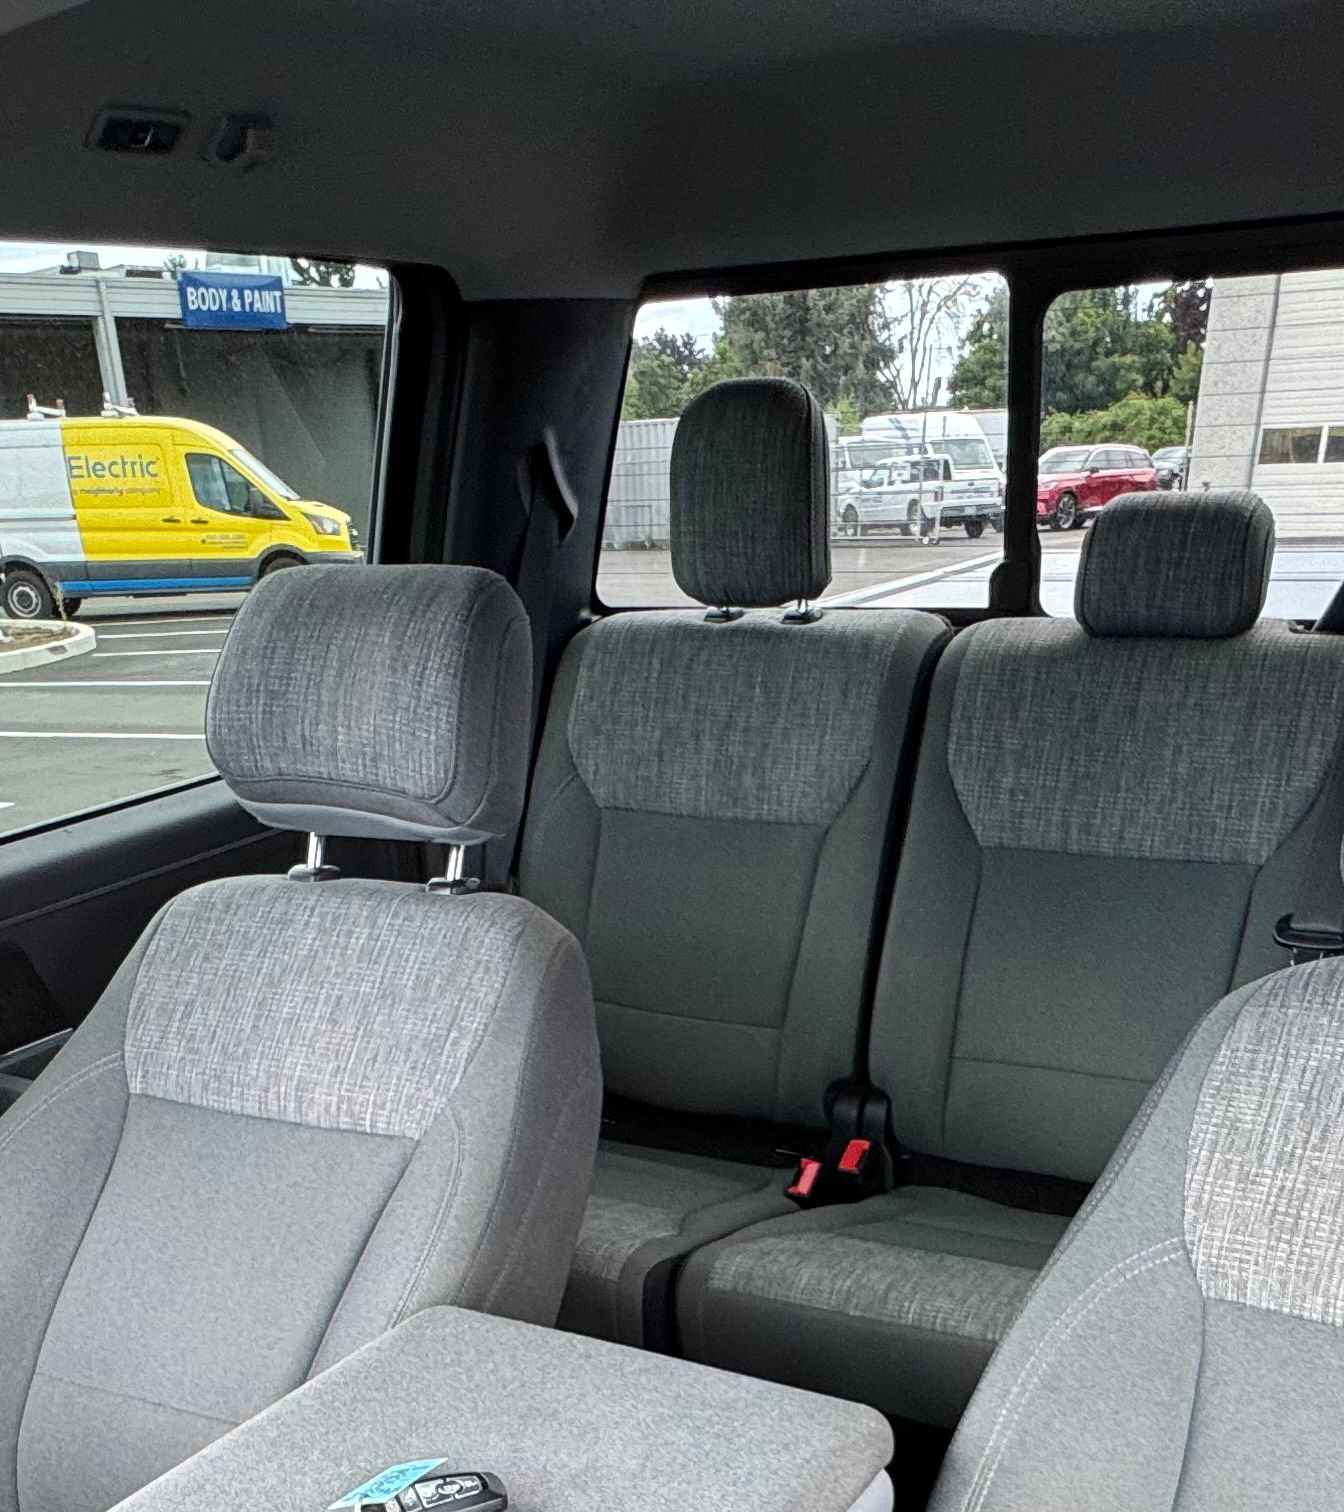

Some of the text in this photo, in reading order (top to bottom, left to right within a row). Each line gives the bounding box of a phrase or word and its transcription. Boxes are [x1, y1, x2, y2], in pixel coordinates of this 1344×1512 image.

[186, 287, 282, 313] BODY & PAINT
[68, 454, 159, 479] Electric
